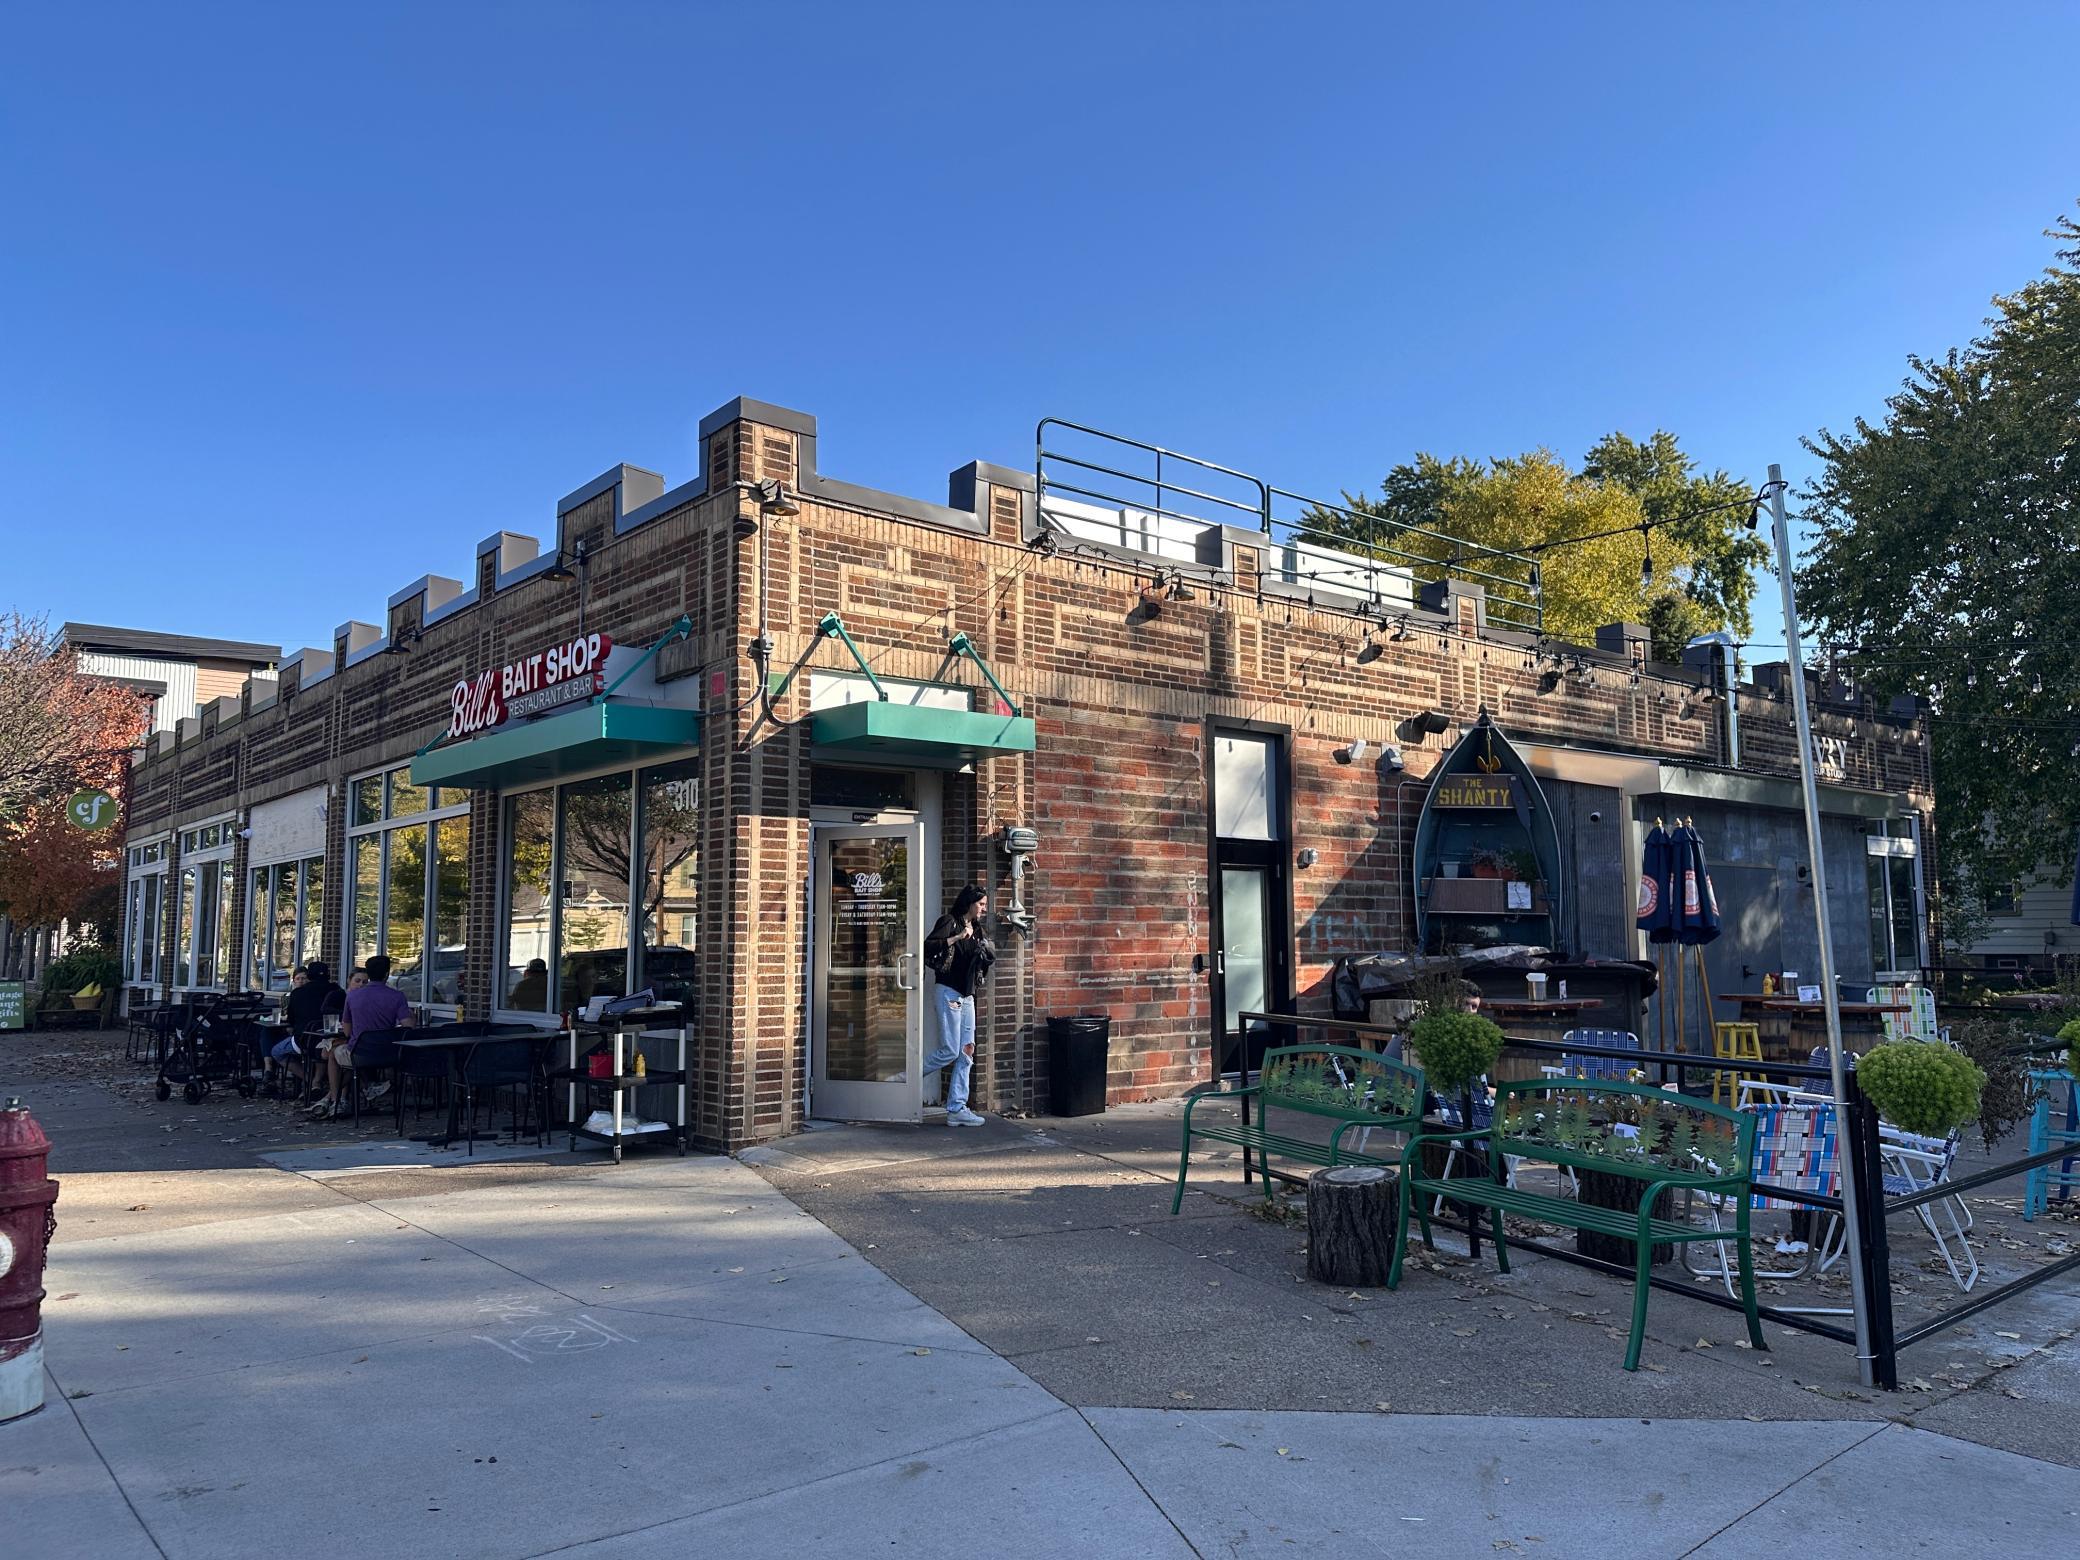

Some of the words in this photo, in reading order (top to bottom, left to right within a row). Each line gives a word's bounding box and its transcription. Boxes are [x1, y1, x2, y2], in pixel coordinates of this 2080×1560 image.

[502, 653, 542, 700] BAIT
[545, 633, 601, 684] SHOP
[447, 670, 500, 738] Bill's
[509, 690, 562, 717] RESTAURANT
[563, 685, 572, 699] &
[573, 677, 593, 696] BAR
[1463, 778, 1483, 788] THE
[1826, 768, 1847, 779] STUDIO
[1440, 788, 1510, 806] SHANTY
